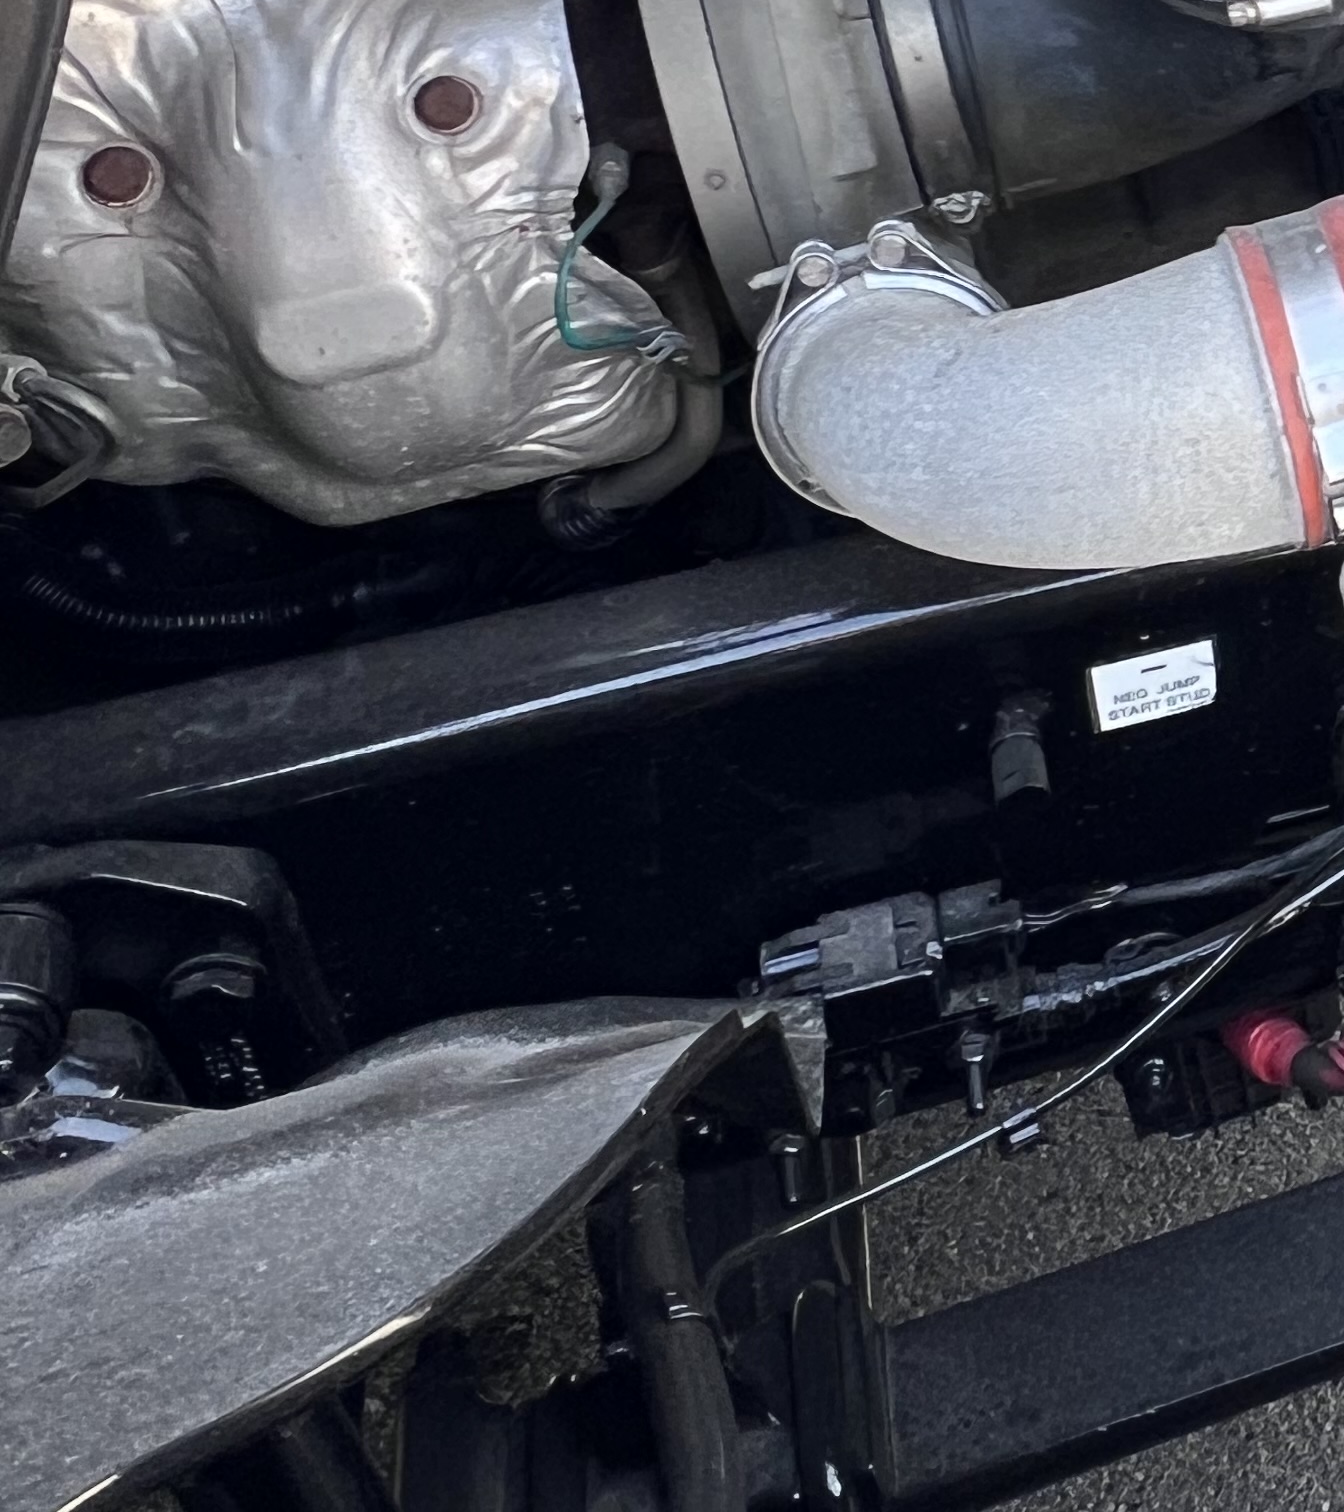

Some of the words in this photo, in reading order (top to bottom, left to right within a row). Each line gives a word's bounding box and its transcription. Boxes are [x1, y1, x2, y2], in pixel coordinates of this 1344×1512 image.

[1156, 675, 1200, 694] JUMP
[1108, 698, 1162, 721] START
[1166, 687, 1211, 707] STUD
